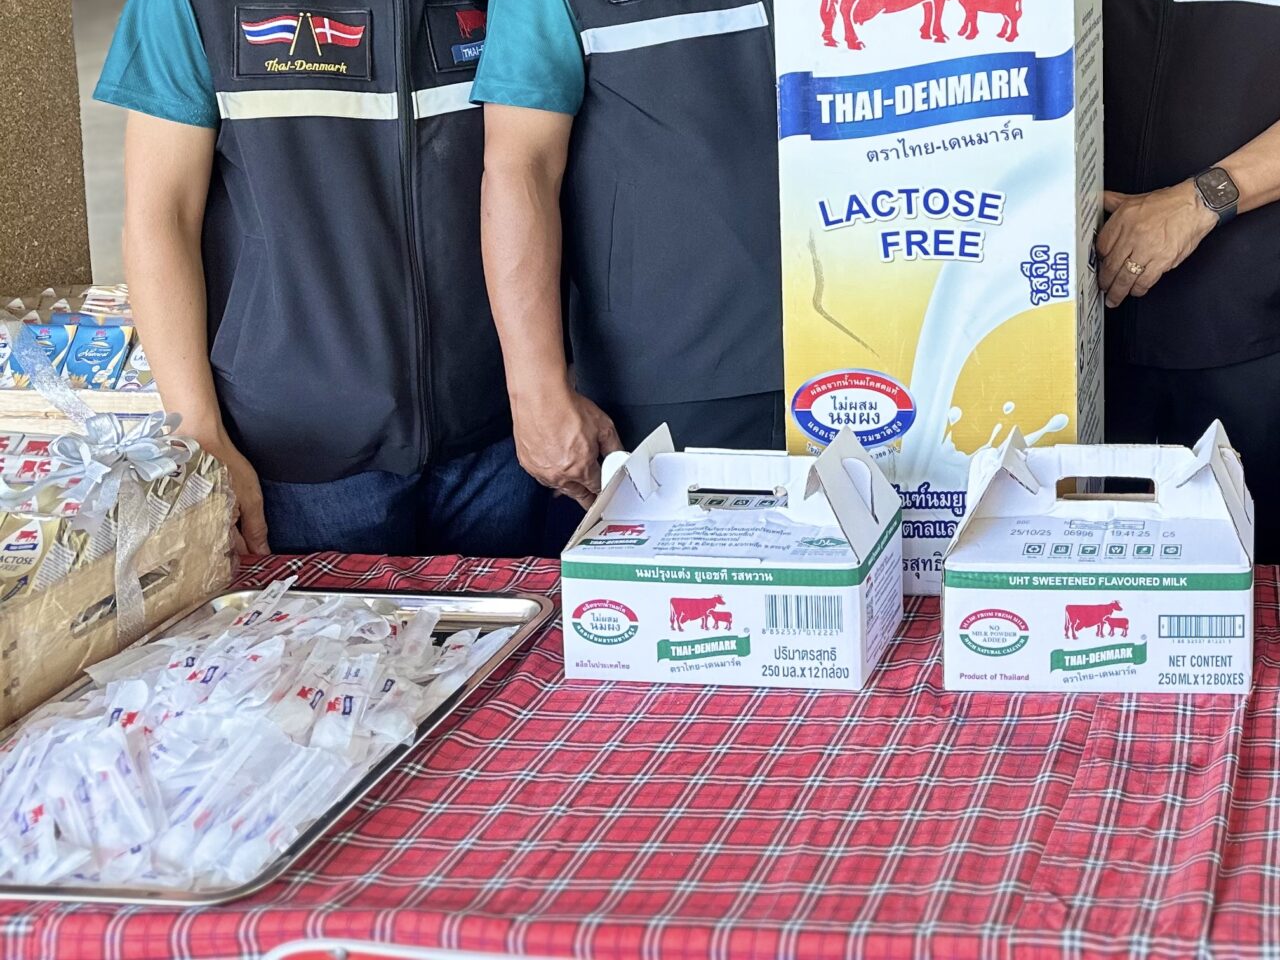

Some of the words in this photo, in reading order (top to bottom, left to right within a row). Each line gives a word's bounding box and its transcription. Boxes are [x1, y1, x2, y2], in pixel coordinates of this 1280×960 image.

[265, 58, 347, 74] Thai-Denmark
[817, 67, 1029, 124] THAI-DENMARK
[866, 120, 1024, 163] ตราไทย-เดนมาร์ค
[818, 188, 1003, 227] LACTOSE
[881, 229, 981, 259] FREE
[1021, 245, 1050, 305] รสจืด
[1050, 252, 1070, 298] Plain
[810, 375, 899, 396] ผลิตจากน้ำนมโคสดแท้
[831, 395, 878, 411] ไม่ผสม
[828, 411, 881, 425] นมผง
[899, 482, 967, 516] ณฑ์นมยู
[902, 521, 958, 538] ตาลแล
[1010, 529, 1052, 537] 25/10/25
[0, 555, 34, 565] ACTOSE
[902, 551, 942, 579] รสุทธิ
[635, 567, 690, 582] นมปรุงแต่ง
[694, 568, 728, 583] ยูเอชที
[732, 571, 773, 582] รสหวาน
[1009, 576, 1030, 586] UHT
[1032, 576, 1096, 586] SWEETENED
[1098, 576, 1160, 586] FLAVOURED
[1162, 576, 1187, 586] MILK
[591, 623, 621, 632] นมผง
[670, 641, 737, 657] THAI-DENMARK
[1064, 648, 1133, 665] THAI-DENMARK
[774, 646, 837, 669] ปริมาตรสุทธิ
[1169, 655, 1186, 667] NET
[1190, 655, 1232, 667] CONTENT
[762, 665, 780, 678] 250
[959, 672, 988, 680] Product
